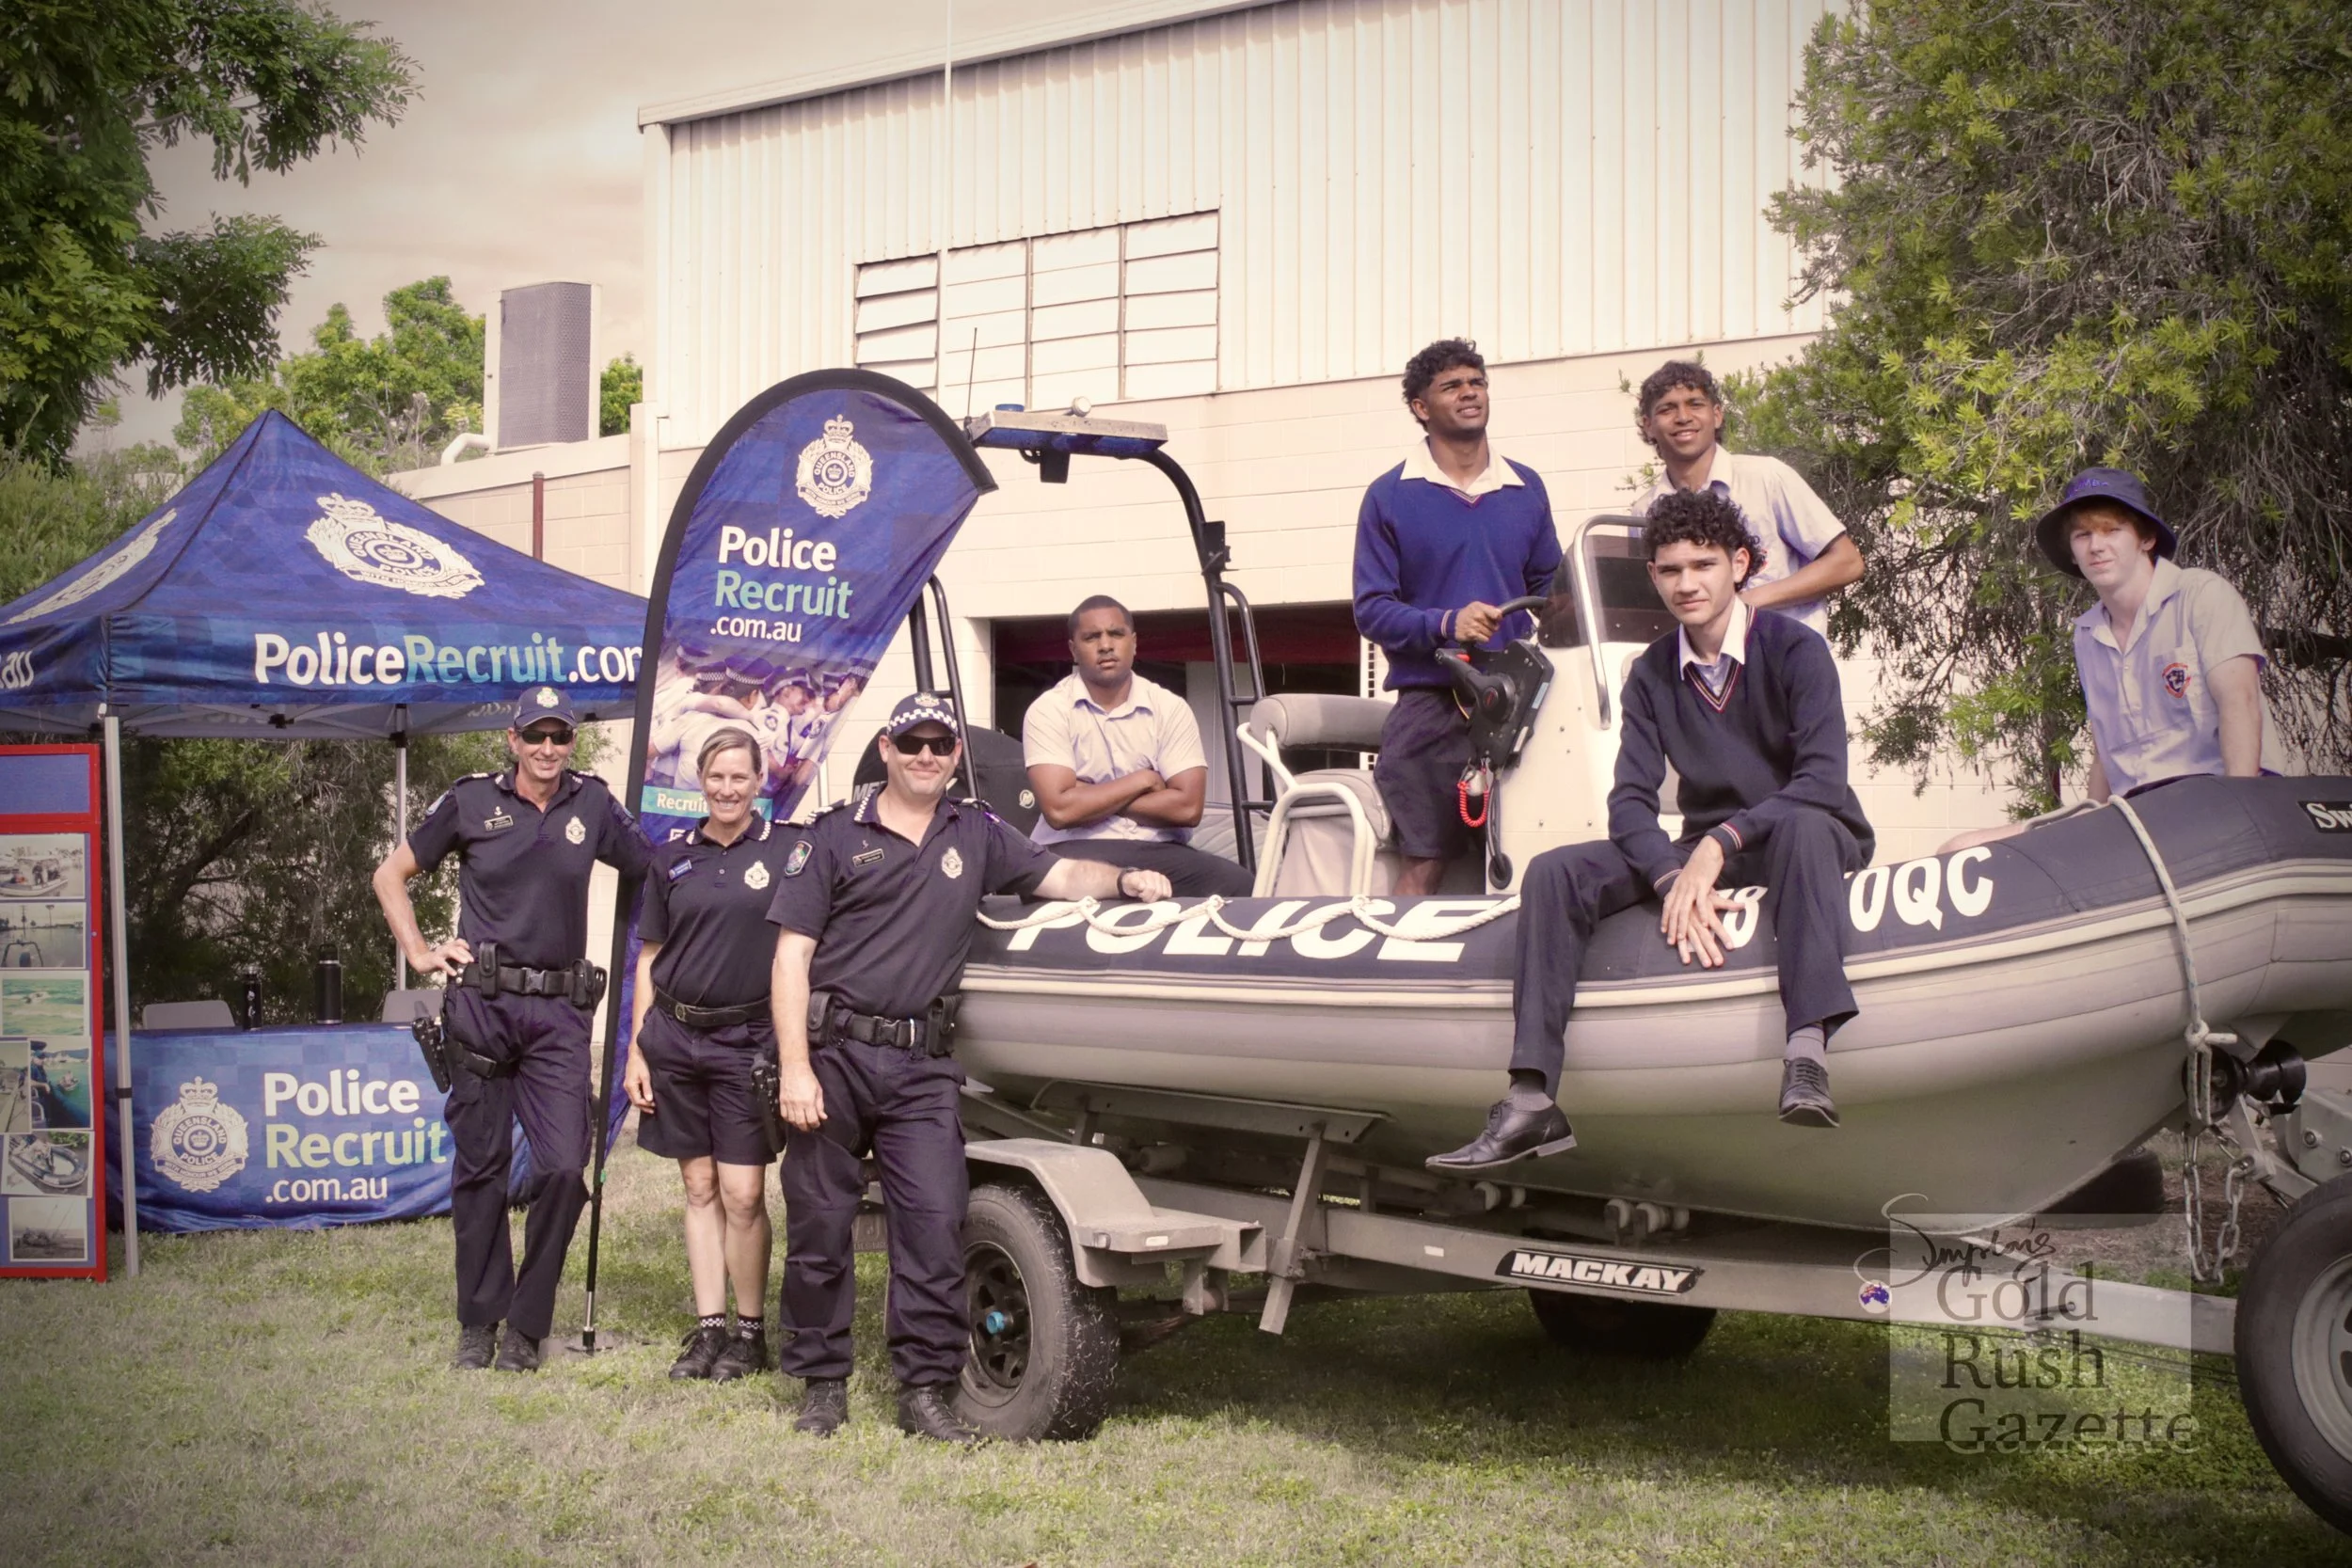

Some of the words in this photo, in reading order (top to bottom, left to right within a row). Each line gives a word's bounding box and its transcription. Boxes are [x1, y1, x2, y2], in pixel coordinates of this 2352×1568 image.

[814, 451, 855, 478] QUEENSLAND
[348, 531, 434, 560] QUEENSLAND
[718, 525, 836, 572] Police
[379, 563, 438, 578] POLICE
[715, 569, 853, 619] Recruit
[710, 616, 802, 642] .com.au
[1007, 899, 1503, 962] POLICE
[263, 1069, 420, 1117] Police
[172, 1117, 227, 1145] QUEENSLAND
[265, 1117, 447, 1168] Recruit
[180, 1151, 219, 1165] POLICE
[265, 1177, 388, 1203] .com.au
[1511, 1252, 1691, 1291] MACKAY
